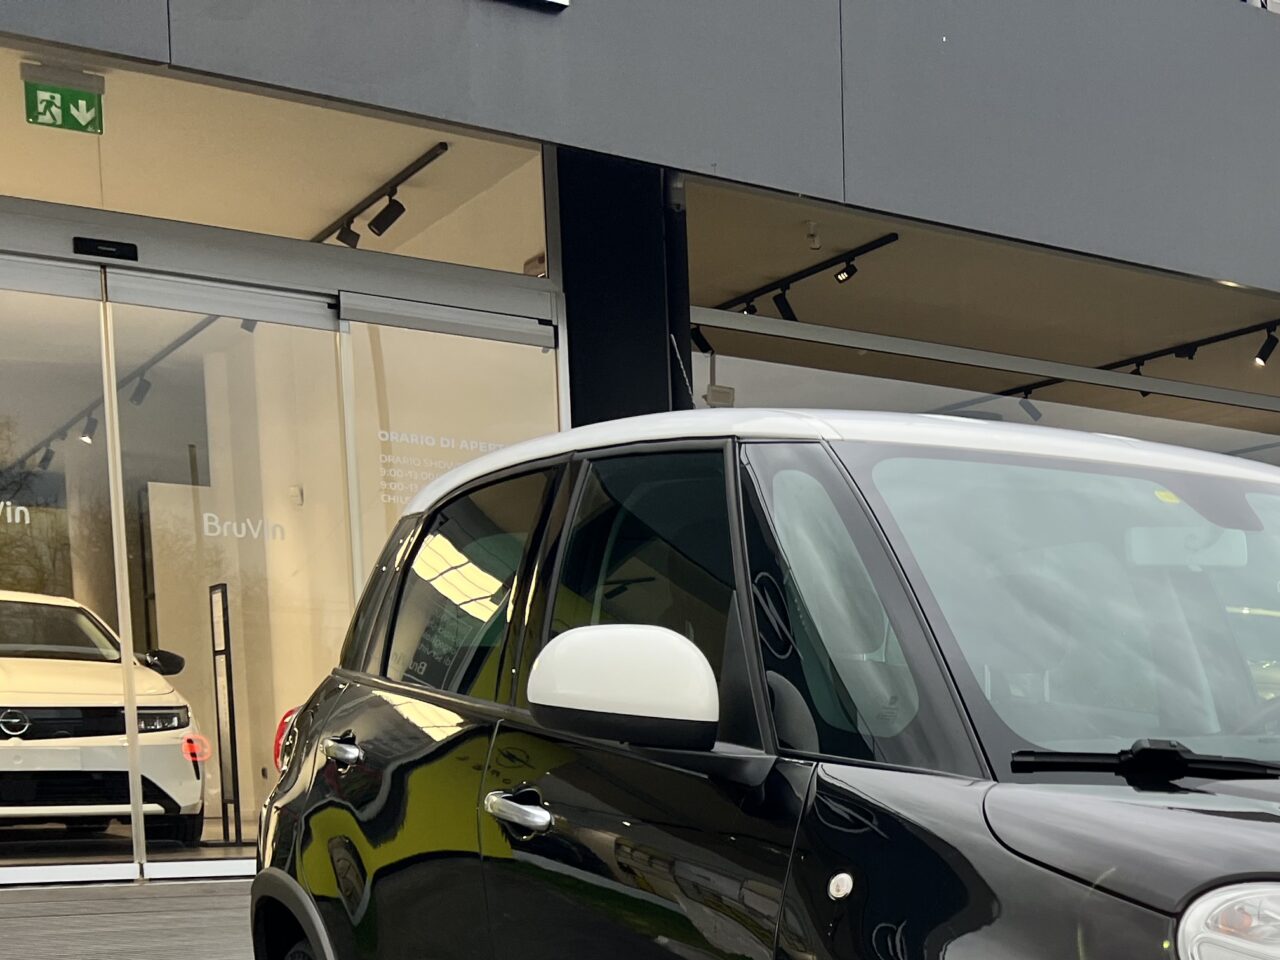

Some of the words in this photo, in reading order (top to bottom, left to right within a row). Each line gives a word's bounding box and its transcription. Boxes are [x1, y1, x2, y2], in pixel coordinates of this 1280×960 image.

[377, 430, 436, 447] ORARIO
[440, 437, 455, 448] DI
[203, 512, 286, 541] BruVin
